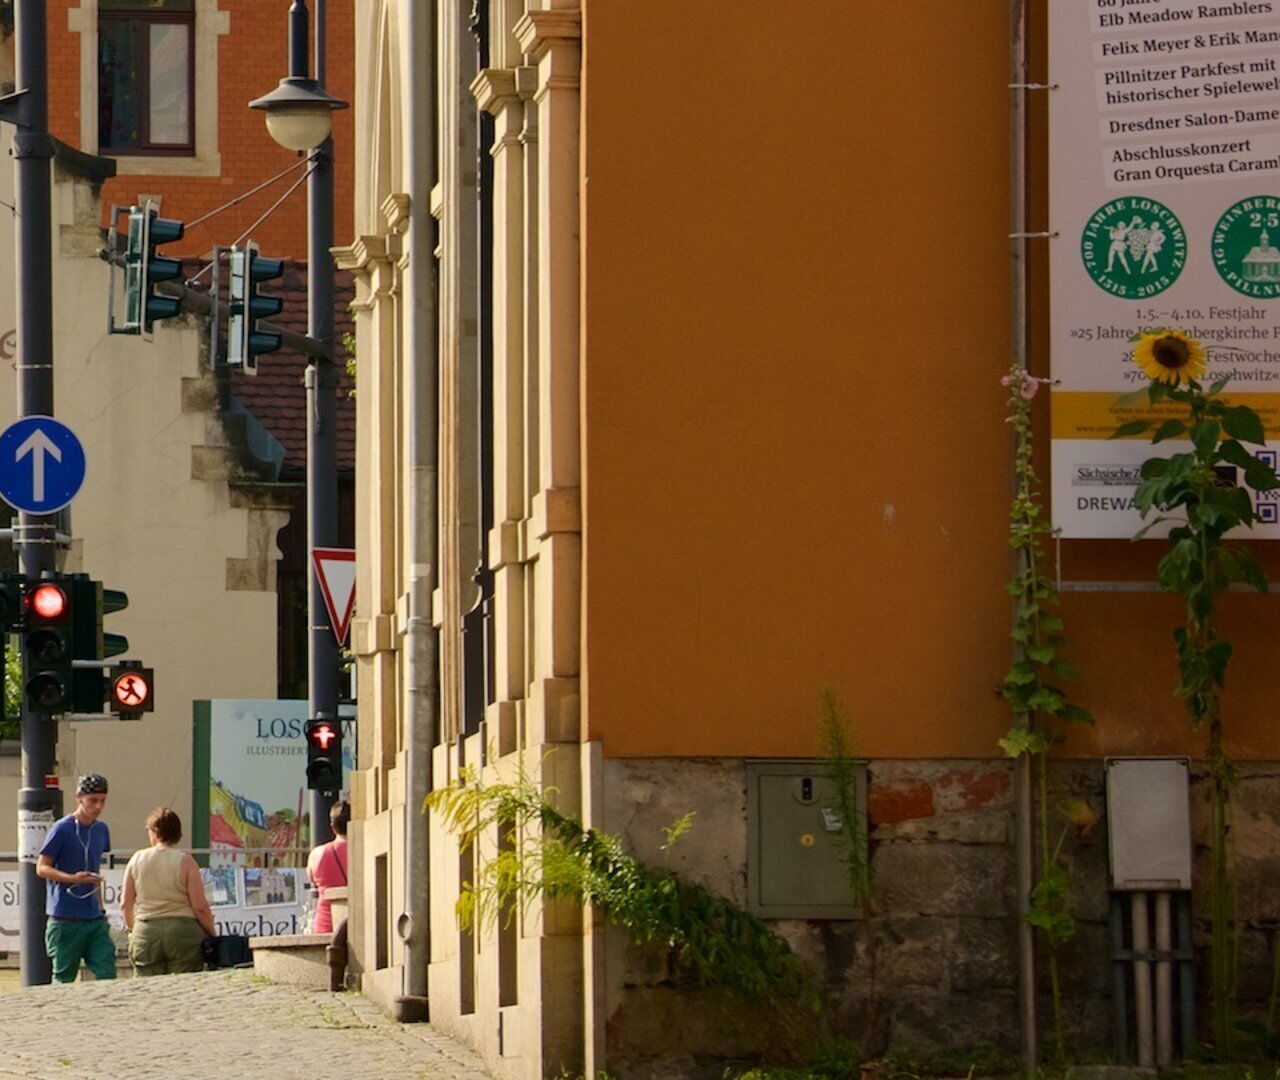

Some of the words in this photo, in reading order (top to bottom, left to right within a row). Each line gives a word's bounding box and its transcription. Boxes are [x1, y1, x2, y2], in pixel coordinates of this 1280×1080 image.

[1099, 12, 1124, 27] Elb
[1128, 7, 1194, 25] Meadow
[1197, 1, 1272, 18] Ramblers
[1101, 41, 1139, 56] Felix
[1143, 37, 1190, 53] Meyer
[1194, 35, 1206, 48] &
[1209, 32, 1241, 47] Erik
[1104, 69, 1177, 85] Pillnitzer
[1180, 61, 1246, 79] Parkfest
[1249, 58, 1276, 72] mit
[1106, 84, 1199, 105] historischer
[1109, 117, 1181, 134] Dresdner
[1184, 108, 1280, 128] Salon-Dame
[1112, 139, 1252, 163] Abschlusskonzert
[1114, 168, 1152, 182] Gran
[1155, 161, 1225, 181] Orquesta
[1209, 306, 1267, 322] Festjahr
[1096, 325, 1134, 341] Jahre
